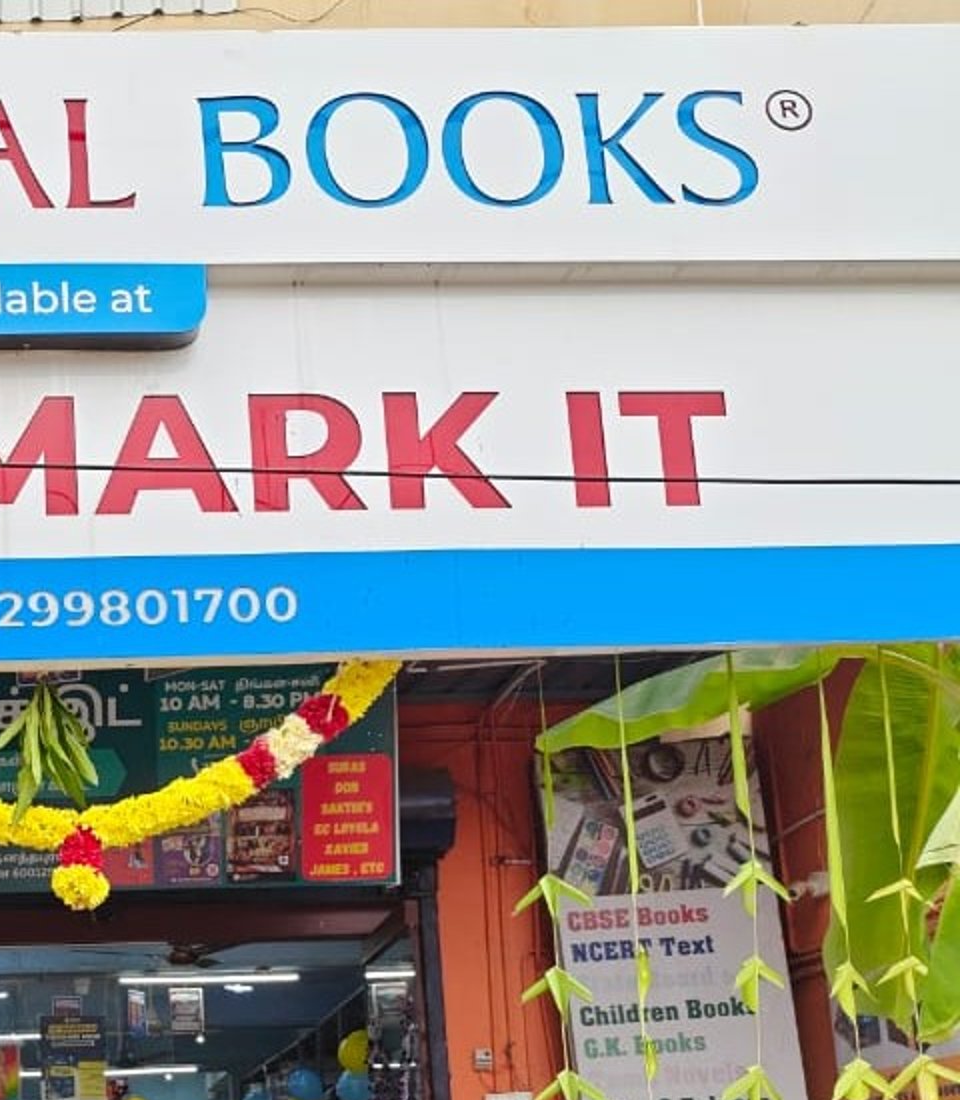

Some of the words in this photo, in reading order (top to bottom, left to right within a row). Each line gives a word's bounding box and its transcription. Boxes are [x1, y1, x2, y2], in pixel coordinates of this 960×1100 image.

[196, 90, 760, 210] BOOKS
[111, 285, 152, 314] at
[565, 390, 727, 509] IT
[165, 679, 226, 692] MON-SAT
[160, 697, 183, 712] 10
[189, 694, 221, 711] AM
[243, 694, 285, 709] 8.30
[167, 719, 228, 733] SUNDAYS
[160, 738, 204, 751] 10.30
[208, 736, 237, 749] AM
[567, 908, 629, 932] CBSE
[636, 904, 709, 927] Books
[571, 939, 652, 963] NCERT
[659, 935, 715, 957] Text
[580, 1000, 679, 1027] Children
[686, 997, 755, 1019] Book
[583, 1037, 628, 1060] G.K.
